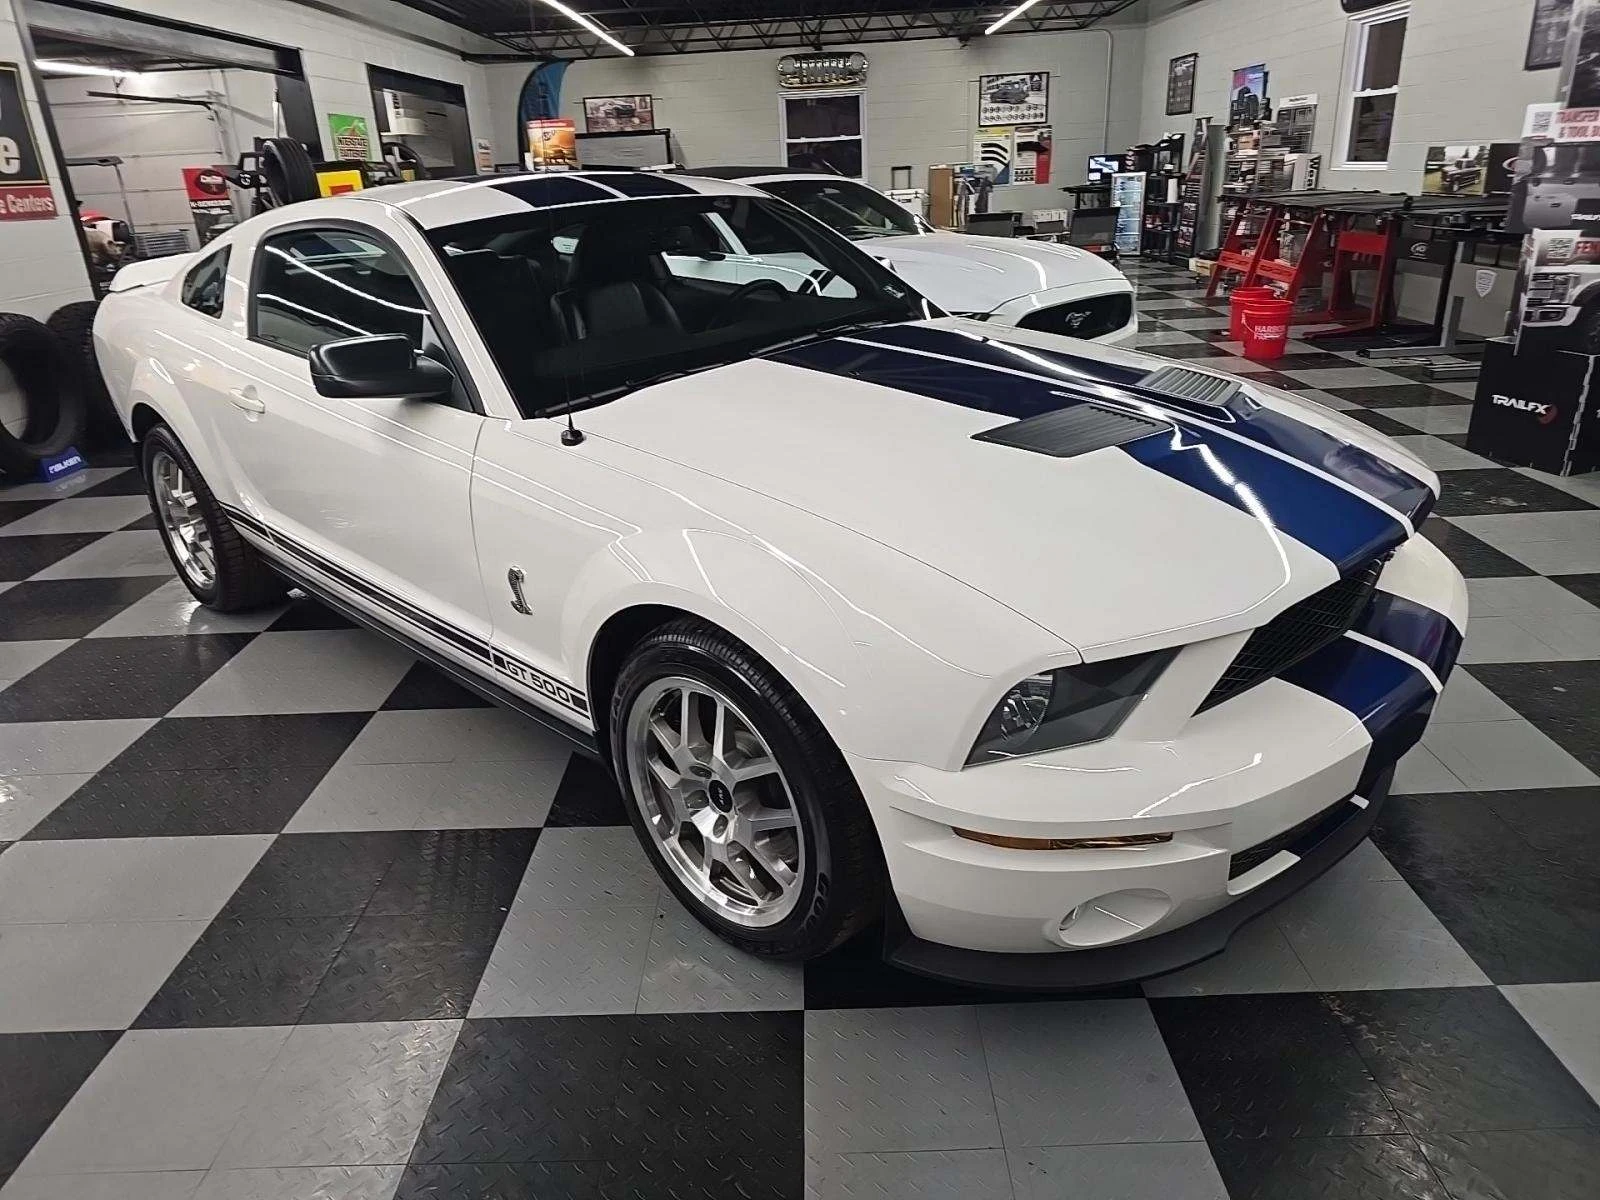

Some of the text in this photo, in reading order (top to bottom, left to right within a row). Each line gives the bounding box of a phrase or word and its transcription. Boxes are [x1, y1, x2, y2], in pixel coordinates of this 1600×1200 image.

[6, 193, 55, 214] Centers
[1491, 394, 1552, 415] TRAILFX
[506, 660, 571, 704] GT 500
